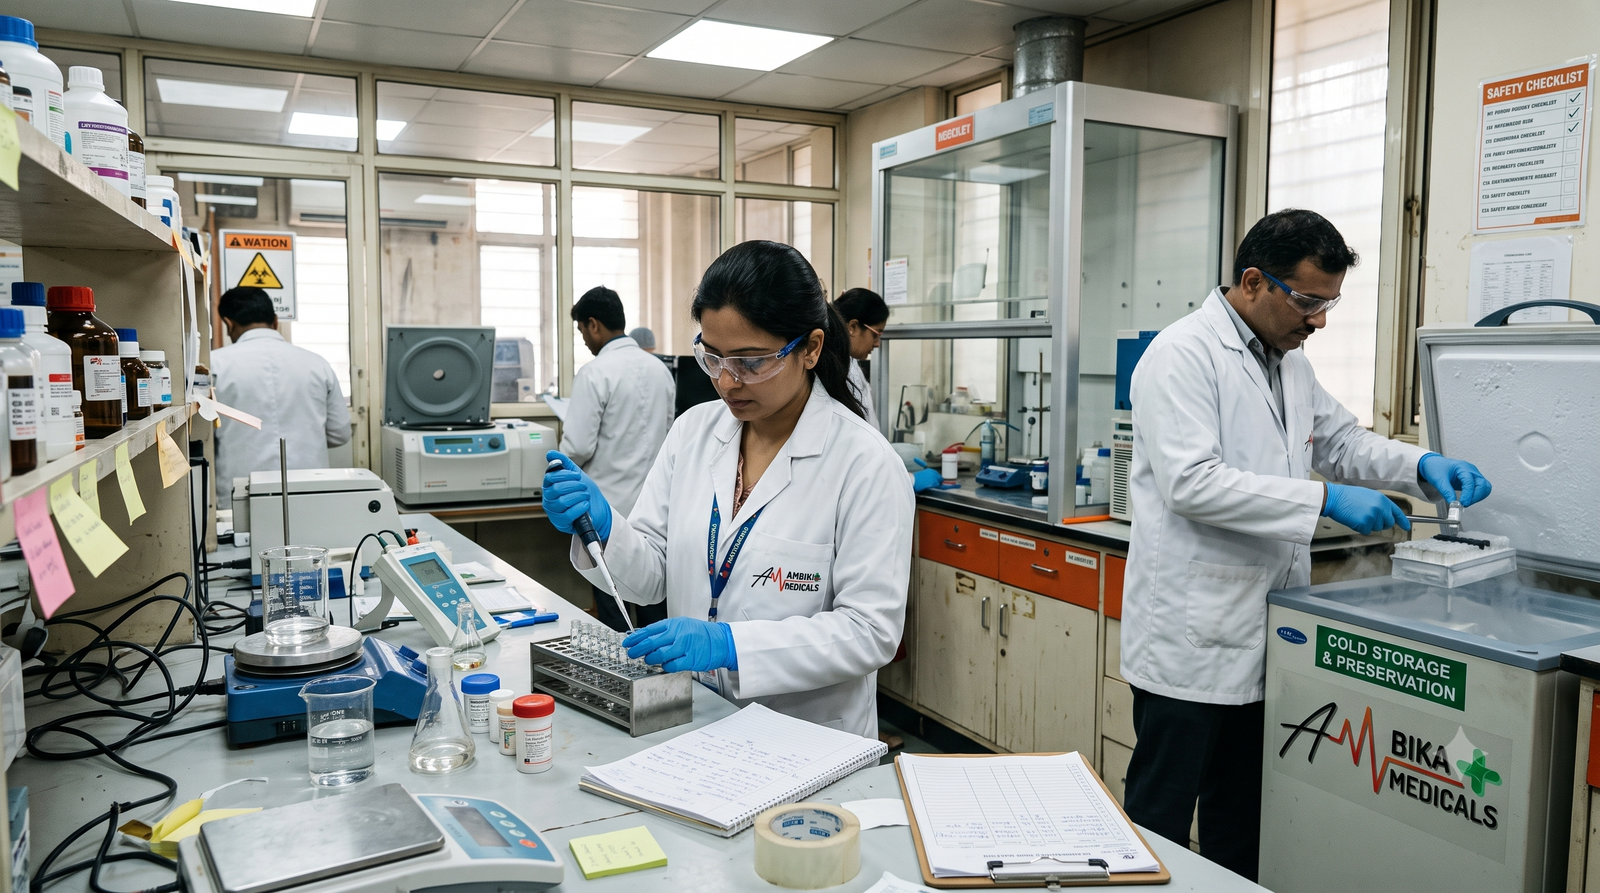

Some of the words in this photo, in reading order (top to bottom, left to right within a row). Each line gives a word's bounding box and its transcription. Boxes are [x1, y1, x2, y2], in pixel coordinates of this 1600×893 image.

[1487, 82, 1524, 100] SAFETY
[1526, 70, 1584, 92] CHECKLIST
[243, 237, 288, 248] WATION
[1322, 650, 1332, 666] &
[1336, 654, 1456, 702] PRESERVATION
[1327, 634, 1368, 656] COLD
[1372, 646, 1451, 680] STORAGE
[1389, 769, 1499, 829] MEDICALS
